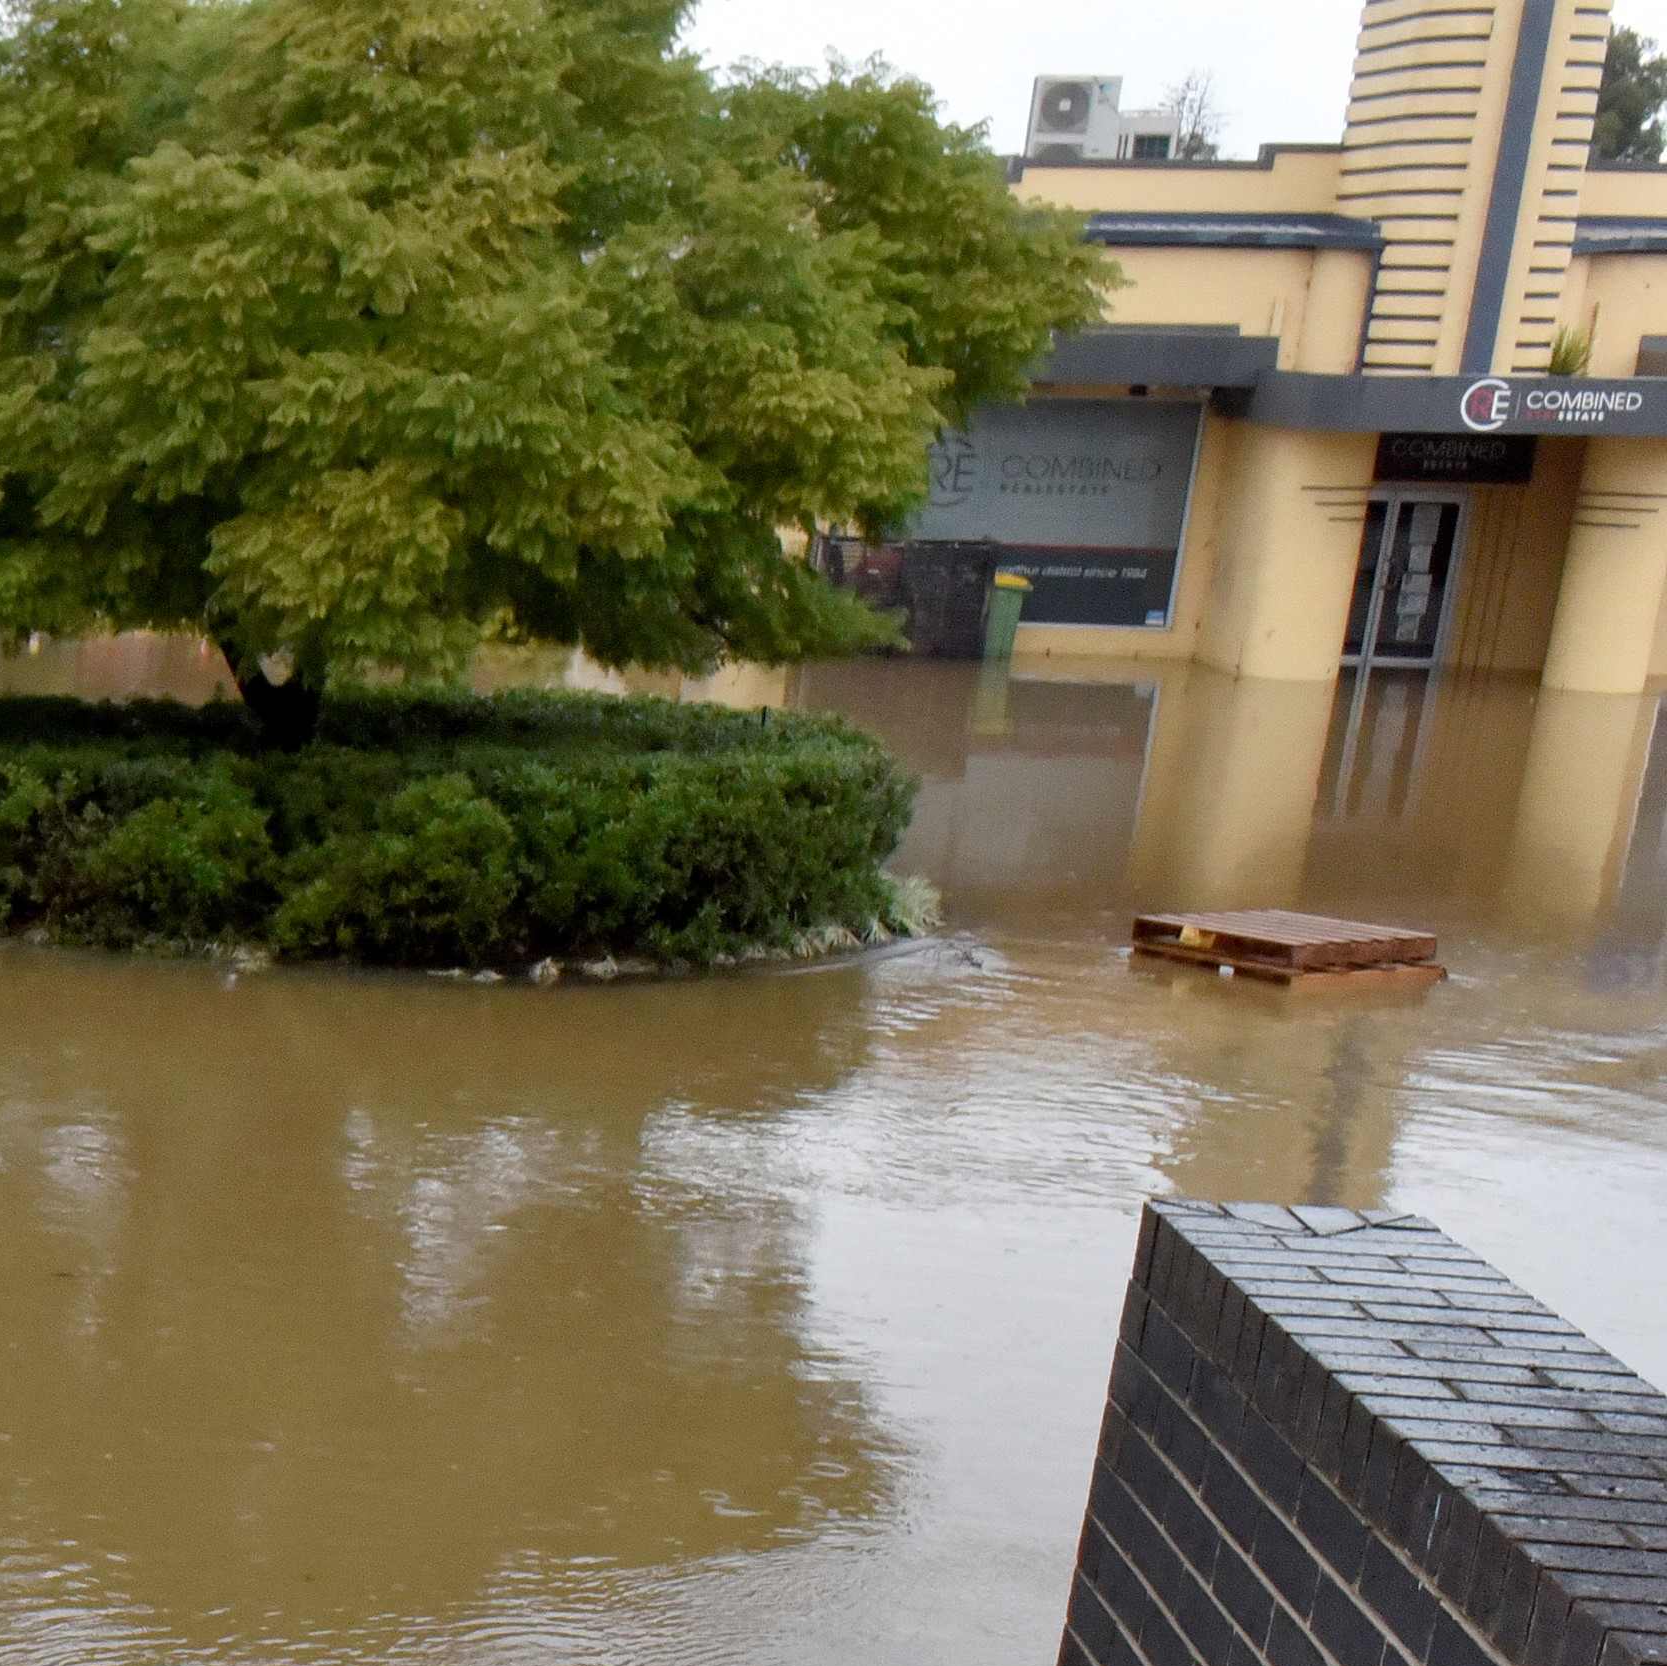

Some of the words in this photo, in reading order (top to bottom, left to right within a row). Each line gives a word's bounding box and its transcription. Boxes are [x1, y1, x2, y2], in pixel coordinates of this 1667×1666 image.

[1526, 390, 1643, 411] COMBINED
[1391, 438, 1507, 459] COMBINED
[1001, 454, 1164, 482] COMBINED
